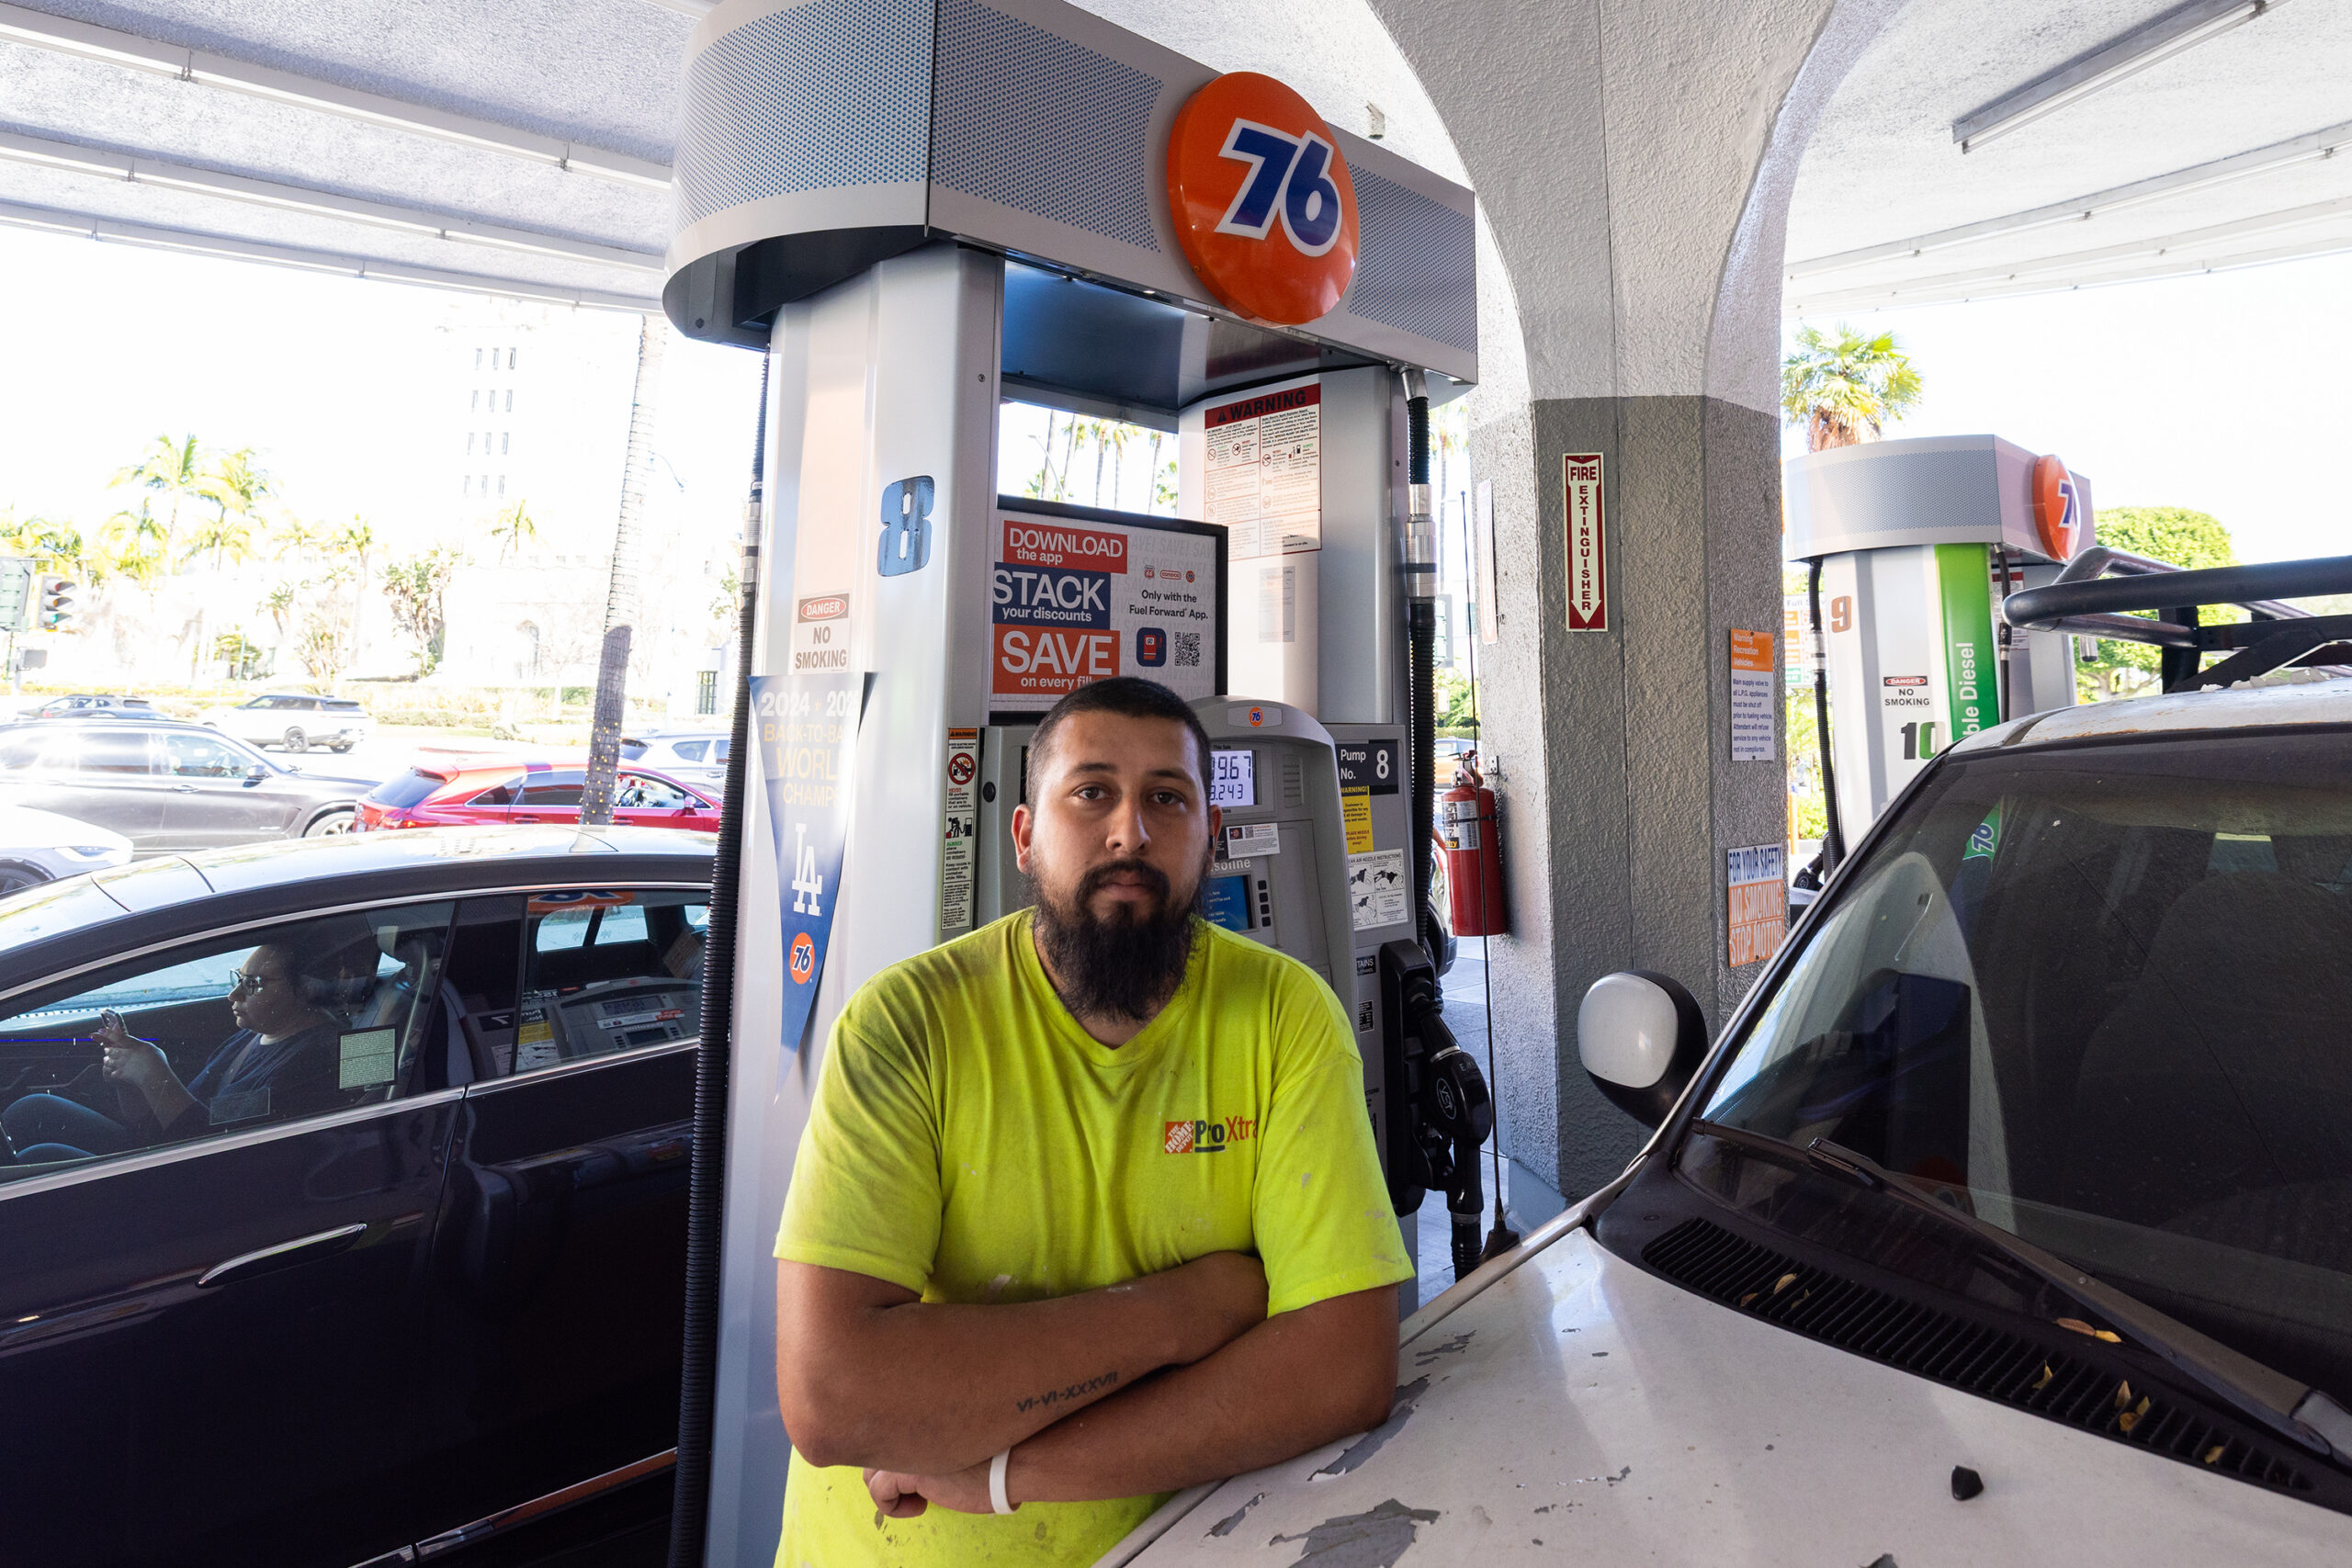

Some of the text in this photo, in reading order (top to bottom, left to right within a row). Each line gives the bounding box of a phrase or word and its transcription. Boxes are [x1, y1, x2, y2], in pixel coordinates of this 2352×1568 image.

[1214, 117, 1342, 257] 76
[1230, 390, 1306, 420] WARNING
[1570, 467, 1597, 480] FIRE
[2058, 479, 2078, 528] 7
[877, 475, 934, 577] 8
[1010, 528, 1123, 557] DOWNLOAD
[1579, 486, 1591, 610] EXTINGUISHER
[1017, 548, 1063, 565] the app
[993, 570, 1105, 611] STACK
[1142, 590, 1197, 603] Only with the
[807, 602, 840, 616] DANGER
[1002, 607, 1091, 622] your discounts
[1129, 604, 1147, 615] Fuel
[1189, 609, 1208, 620] App.
[1831, 595, 1851, 633] 9
[813, 626, 831, 644] NO
[1734, 633, 1753, 644] Warning
[796, 649, 846, 669] SMOKING
[1001, 631, 1112, 674] SAVE
[1734, 645, 1758, 655] Recreation
[1734, 658, 1753, 667] Vehicles
[1021, 677, 1039, 687] on
[1042, 677, 1074, 690] every
[1956, 643, 1977, 700] Diesel
[761, 692, 810, 716] 2024
[1251, 712, 1261, 721] 76
[764, 724, 845, 743] BACK-TO-BA
[1901, 721, 1946, 760] 10
[776, 748, 843, 780] WORL
[1340, 750, 1366, 762] Pump
[1376, 750, 1389, 779] 8
[1340, 768, 1356, 780] No.
[792, 823, 822, 917] LA
[1212, 859, 1251, 872] soline
[1729, 847, 1781, 883] FOR YOUR SAFETY
[1731, 882, 1781, 923] NO SMOKING
[1731, 919, 1782, 964] STOP MOTOR
[792, 943, 812, 974] 76
